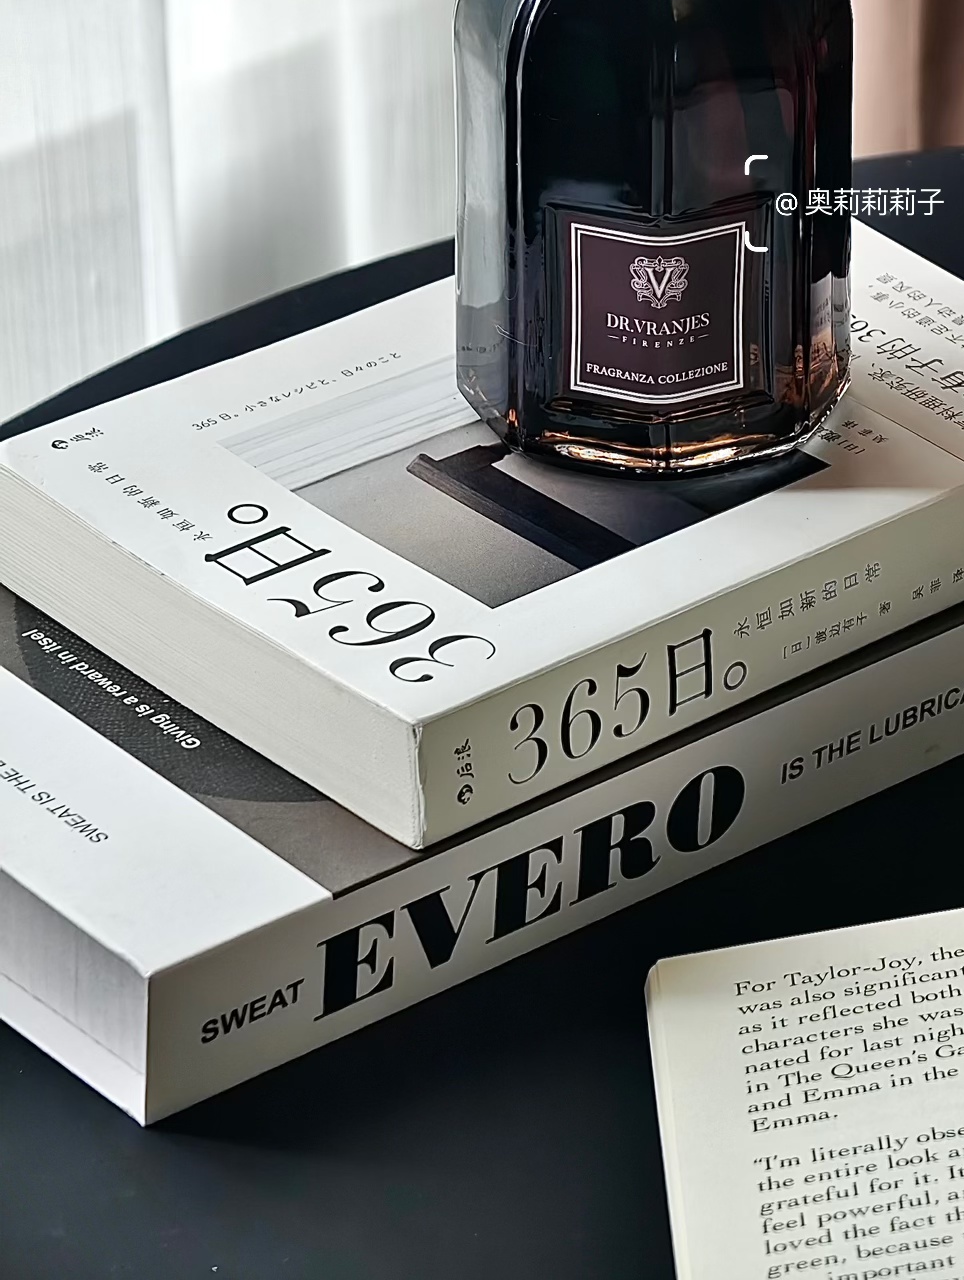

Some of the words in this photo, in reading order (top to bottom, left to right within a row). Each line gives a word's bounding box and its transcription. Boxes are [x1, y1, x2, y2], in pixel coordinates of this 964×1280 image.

[606, 312, 710, 336] DR.VRANJES
[622, 336, 695, 348] FIRENZE
[586, 363, 655, 385] FRAGRANZA
[658, 362, 728, 385] COLLEZIONE
[88, 460, 214, 543] 永恒如新的日常
[734, 562, 882, 638] 永恒如新的日常
[57, 650, 78, 664] in
[69, 661, 128, 697] reward
[123, 696, 139, 705] a
[136, 704, 155, 717] is
[150, 713, 201, 750] Giving
[453, 738, 475, 779] 后浪
[0, 768, 36, 794] THE
[31, 791, 56, 805] IS
[46, 805, 109, 843] SWEAT
[201, 979, 306, 1045] SWEAT
[314, 765, 747, 1021] EVERO
[781, 756, 804, 785] IS
[811, 729, 862, 768] THE
[734, 981, 776, 996] For
[783, 957, 922, 987] Taylor-Joy,
[930, 947, 964, 962] the
[738, 1000, 782, 1015] was
[790, 990, 835, 1006] also
[738, 1024, 762, 1035] as
[771, 1016, 788, 1030] it
[798, 993, 902, 1025] reflected
[910, 984, 962, 1004] both
[742, 1025, 864, 1054] characters
[873, 1015, 909, 1031] she
[918, 1008, 964, 1022] was
[745, 1049, 810, 1074] nated
[820, 1046, 853, 1061] for
[863, 1037, 902, 1053] last
[747, 1080, 769, 1094] in
[777, 1070, 822, 1087] The
[831, 1050, 928, 1079] Queen's
[748, 1093, 792, 1114] and
[803, 1082, 881, 1103] Emma
[890, 1074, 913, 1088] in
[923, 1066, 958, 1082] the
[752, 1111, 838, 1132] Emma.
